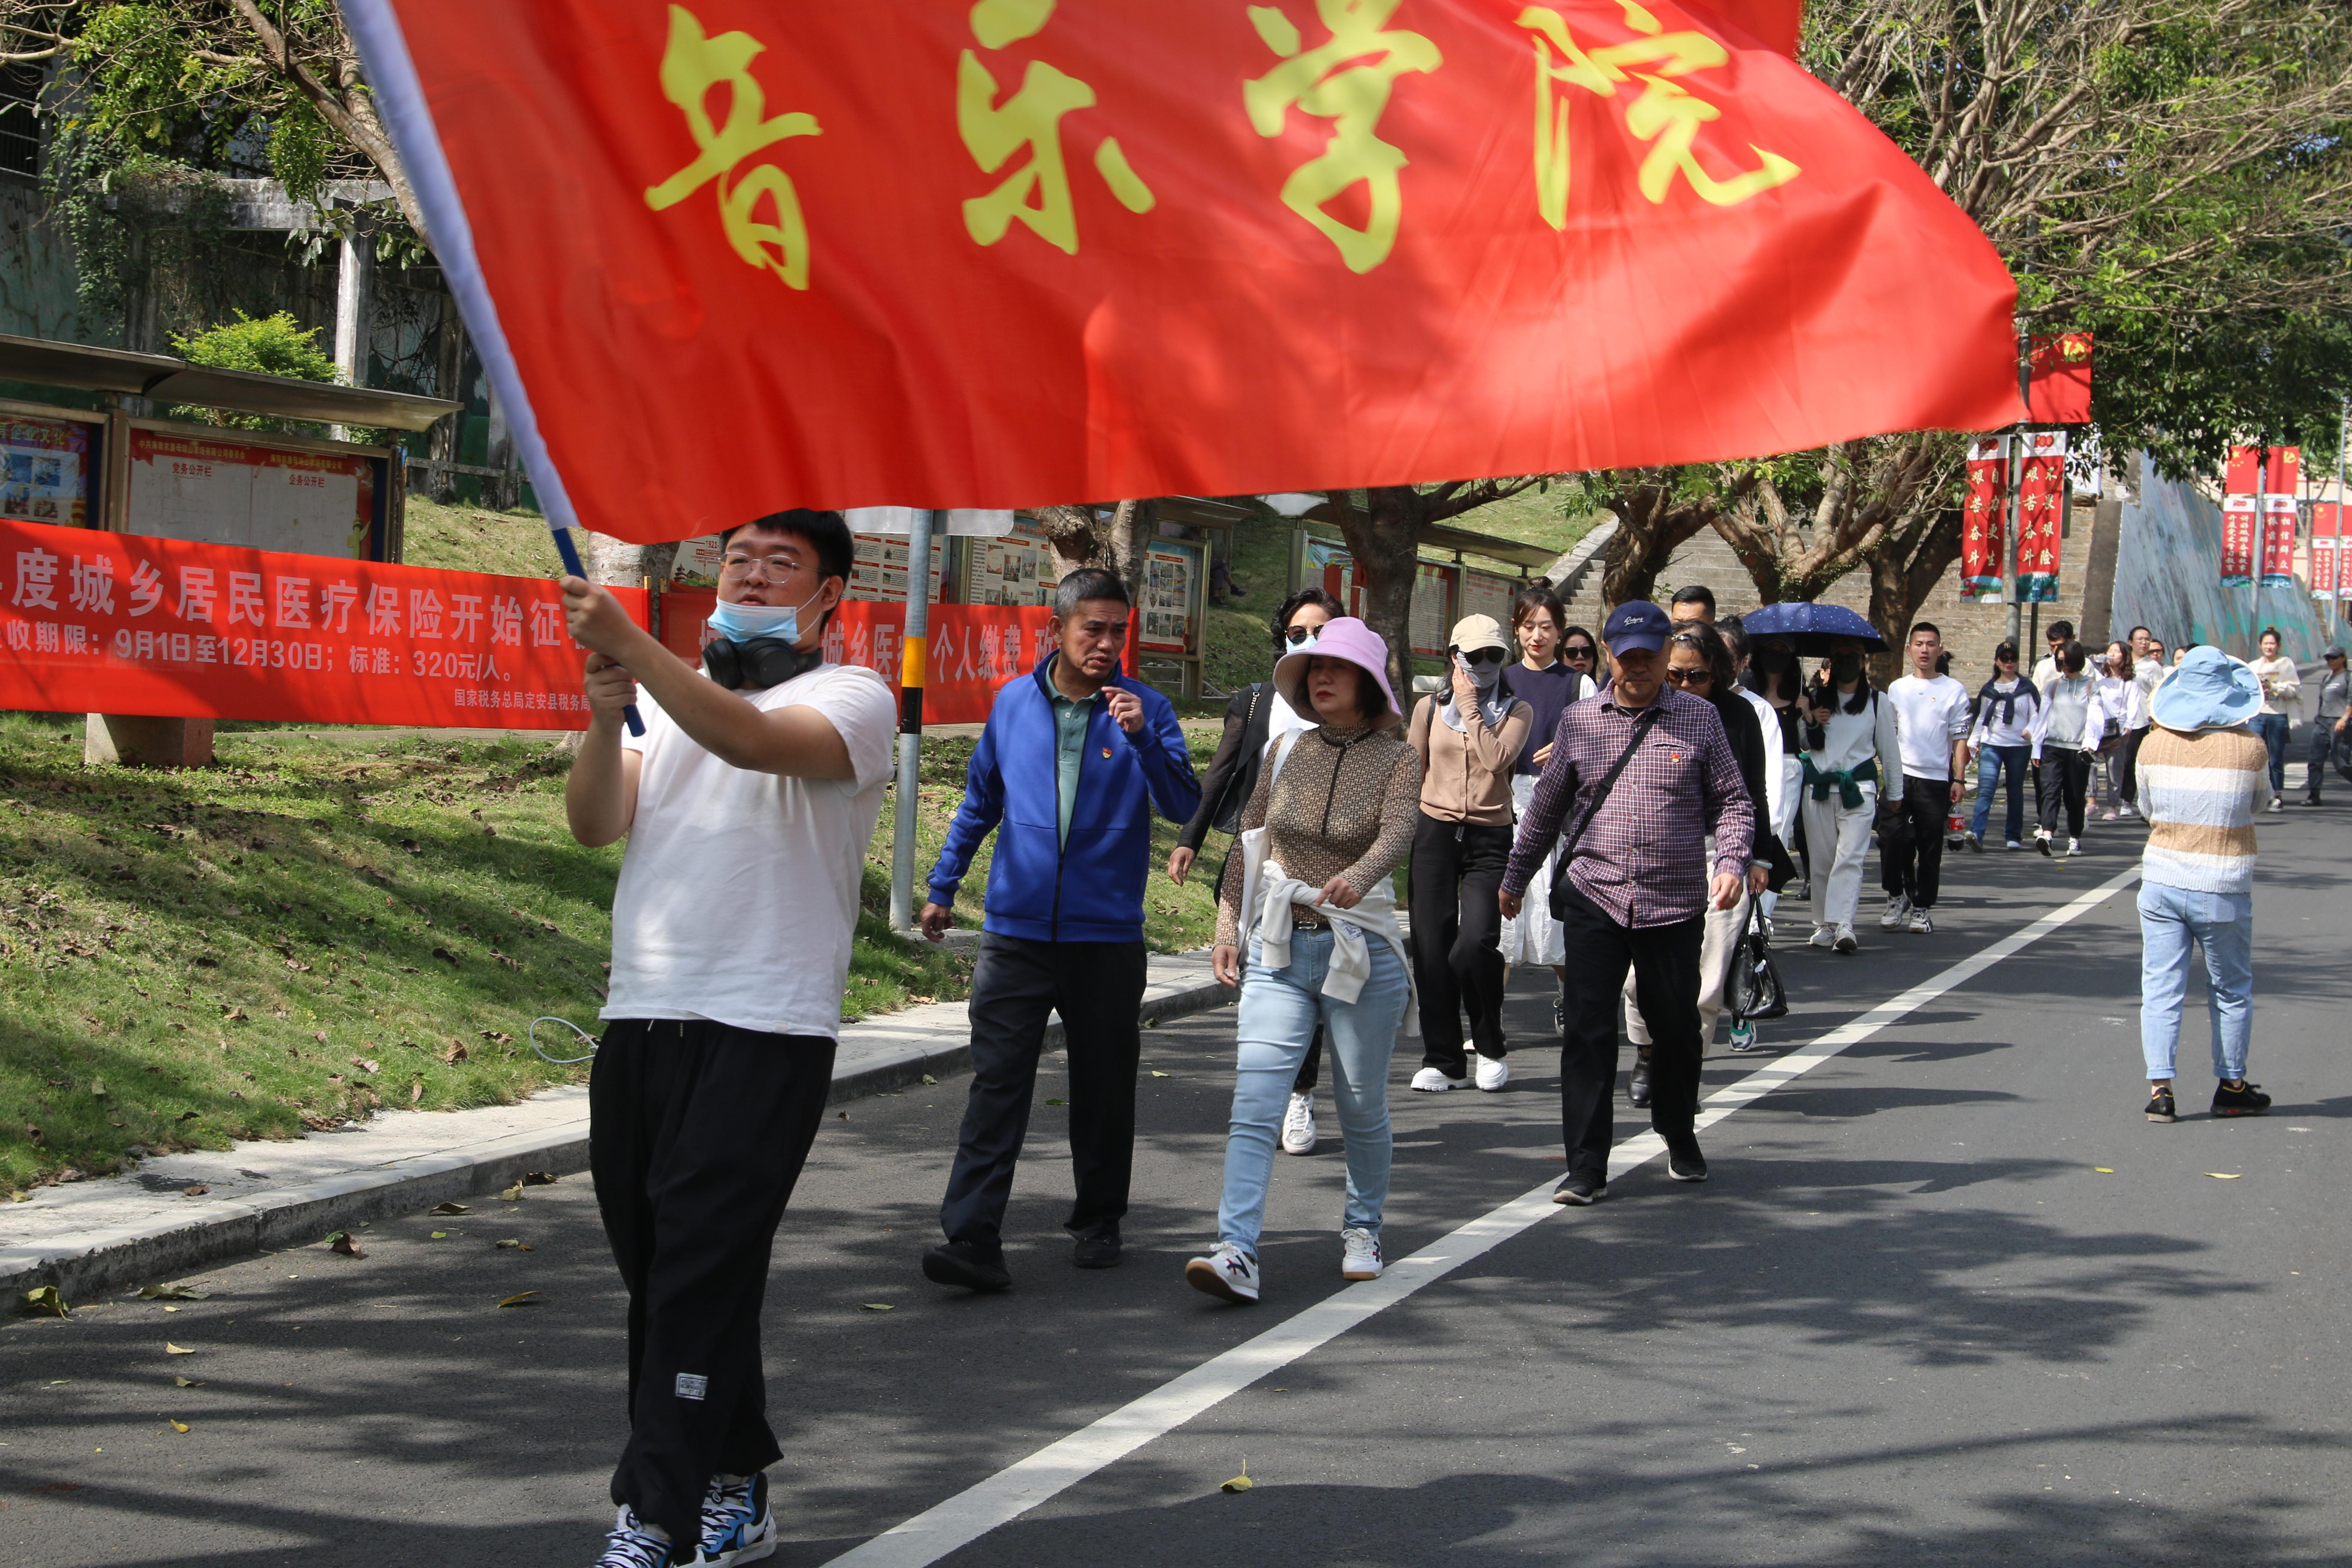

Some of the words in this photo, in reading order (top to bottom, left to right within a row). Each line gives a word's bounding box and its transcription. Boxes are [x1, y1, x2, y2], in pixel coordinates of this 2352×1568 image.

[172, 462, 212, 477] 党务公开栏
[289, 474, 325, 488] 企务公开栏
[2022, 466, 2039, 567] 艰苦奋斗
[706, 540, 721, 549] 1921-
[0, 547, 585, 649] 度城乡居民医疗保险开始征
[454, 688, 591, 711] 国家税务总局定安县税务局
